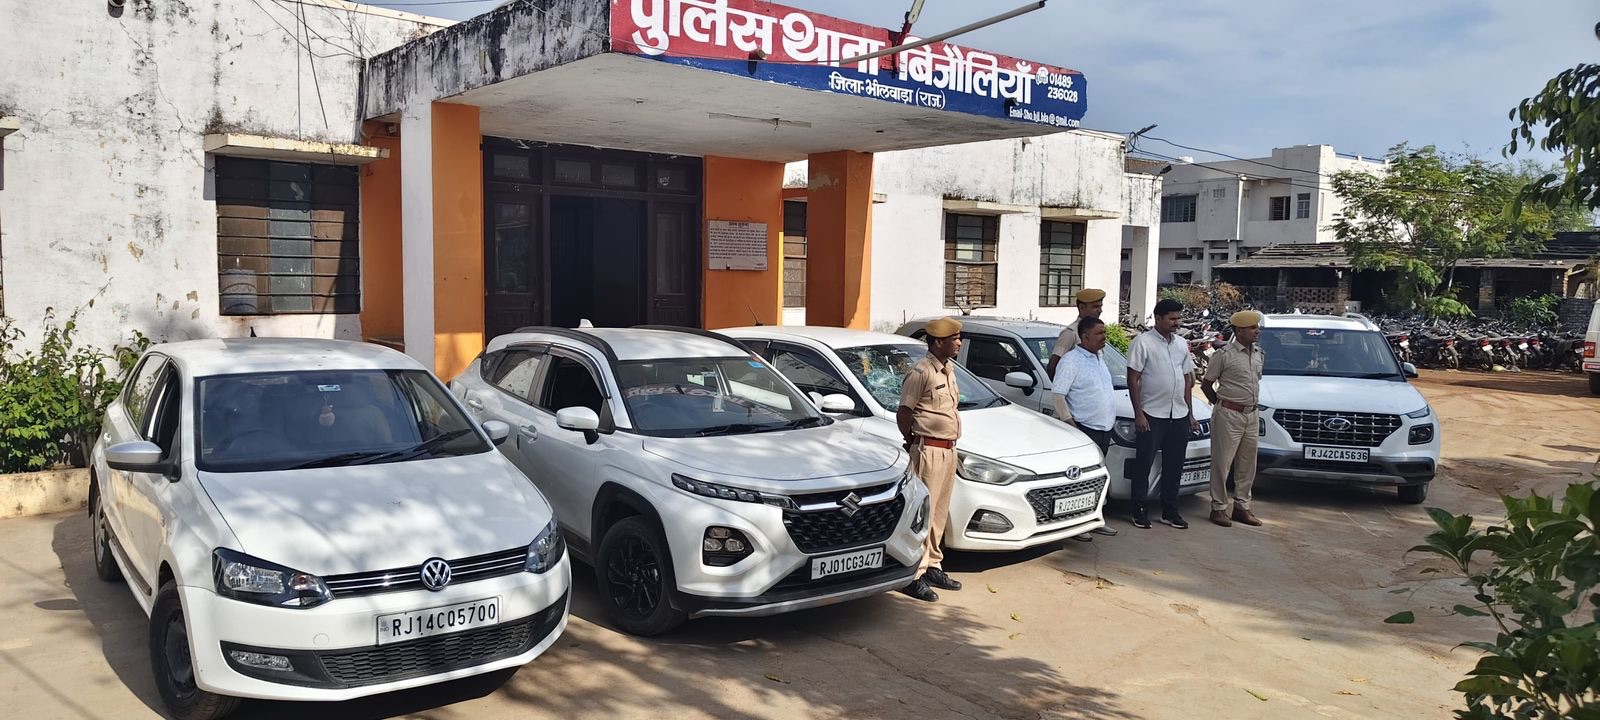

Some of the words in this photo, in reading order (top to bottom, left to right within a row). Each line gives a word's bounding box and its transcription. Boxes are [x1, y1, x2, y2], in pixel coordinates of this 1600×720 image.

[631, 0, 778, 55] पुलिस
[780, 13, 885, 76] थाना
[899, 36, 1035, 104] बिजौलियाँ
[1047, 86, 1078, 103] 236028
[1311, 448, 1368, 461] RJ42CA5636
[819, 551, 882, 575] RJ01CG3477
[392, 603, 496, 637] RJ14CQ5700
